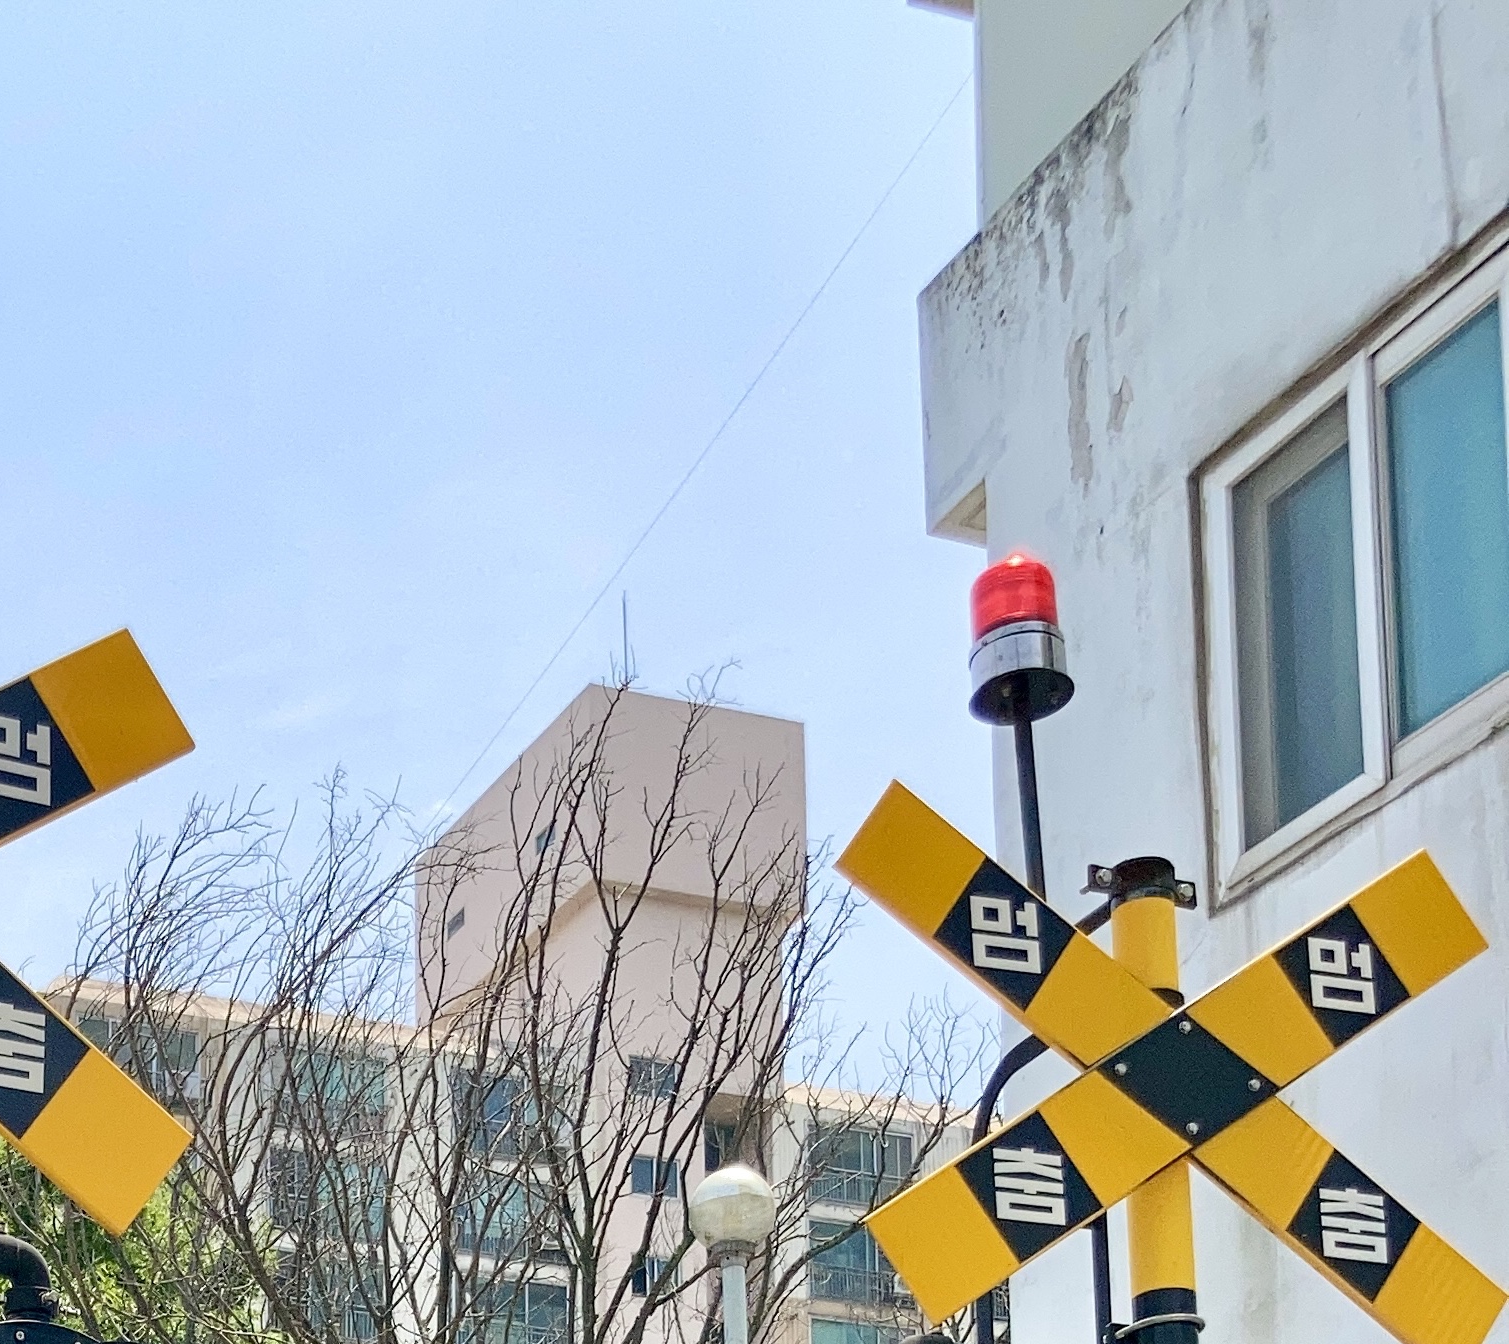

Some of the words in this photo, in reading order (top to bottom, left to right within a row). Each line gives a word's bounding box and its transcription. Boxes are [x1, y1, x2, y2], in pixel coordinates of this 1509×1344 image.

[970, 894, 1042, 975] 멈
[1307, 936, 1377, 1015] 멈
[993, 1146, 1067, 1227] 춤
[1319, 1187, 1388, 1264] 춤
